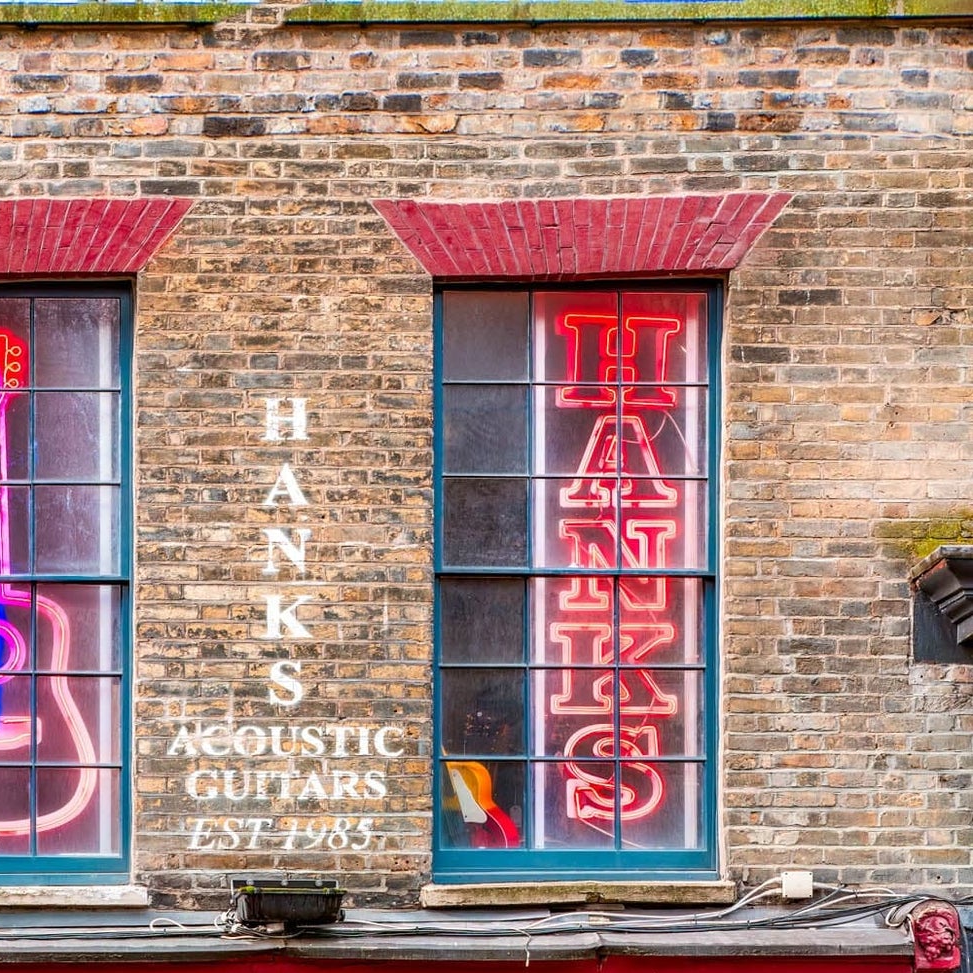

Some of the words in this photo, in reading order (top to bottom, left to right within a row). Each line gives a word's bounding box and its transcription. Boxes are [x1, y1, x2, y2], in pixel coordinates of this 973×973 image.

[262, 397, 314, 707] HANKS
[550, 314, 681, 821] HANKS
[166, 725, 405, 758] ACOUSTIC
[186, 769, 386, 801] GUITARS
[187, 818, 274, 851] EST
[280, 817, 374, 852] 1985
